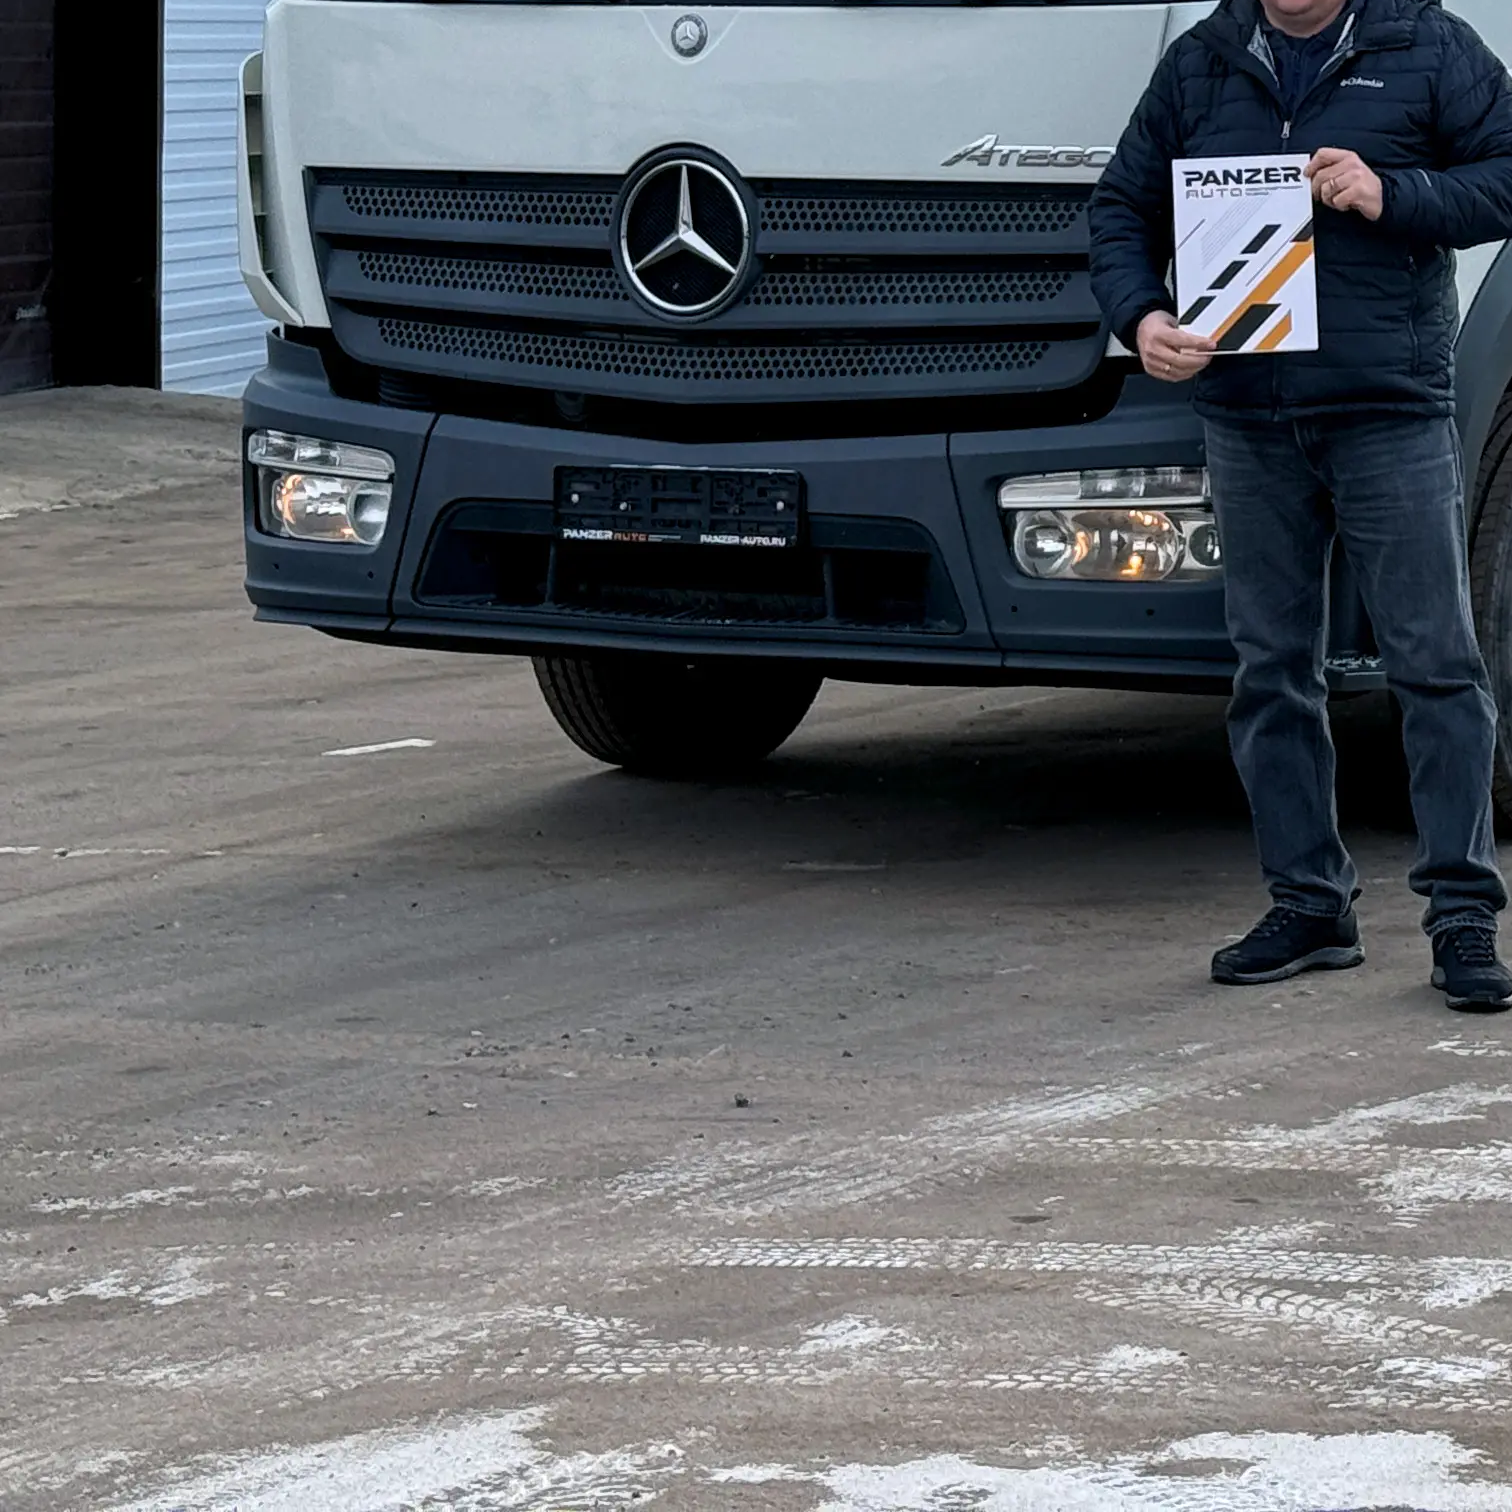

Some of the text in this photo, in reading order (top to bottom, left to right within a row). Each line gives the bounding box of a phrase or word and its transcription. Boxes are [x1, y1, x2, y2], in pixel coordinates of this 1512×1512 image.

[1182, 166, 1303, 187] PANZER
[1186, 188, 1243, 199] AUTO
[562, 528, 613, 540] PANZER
